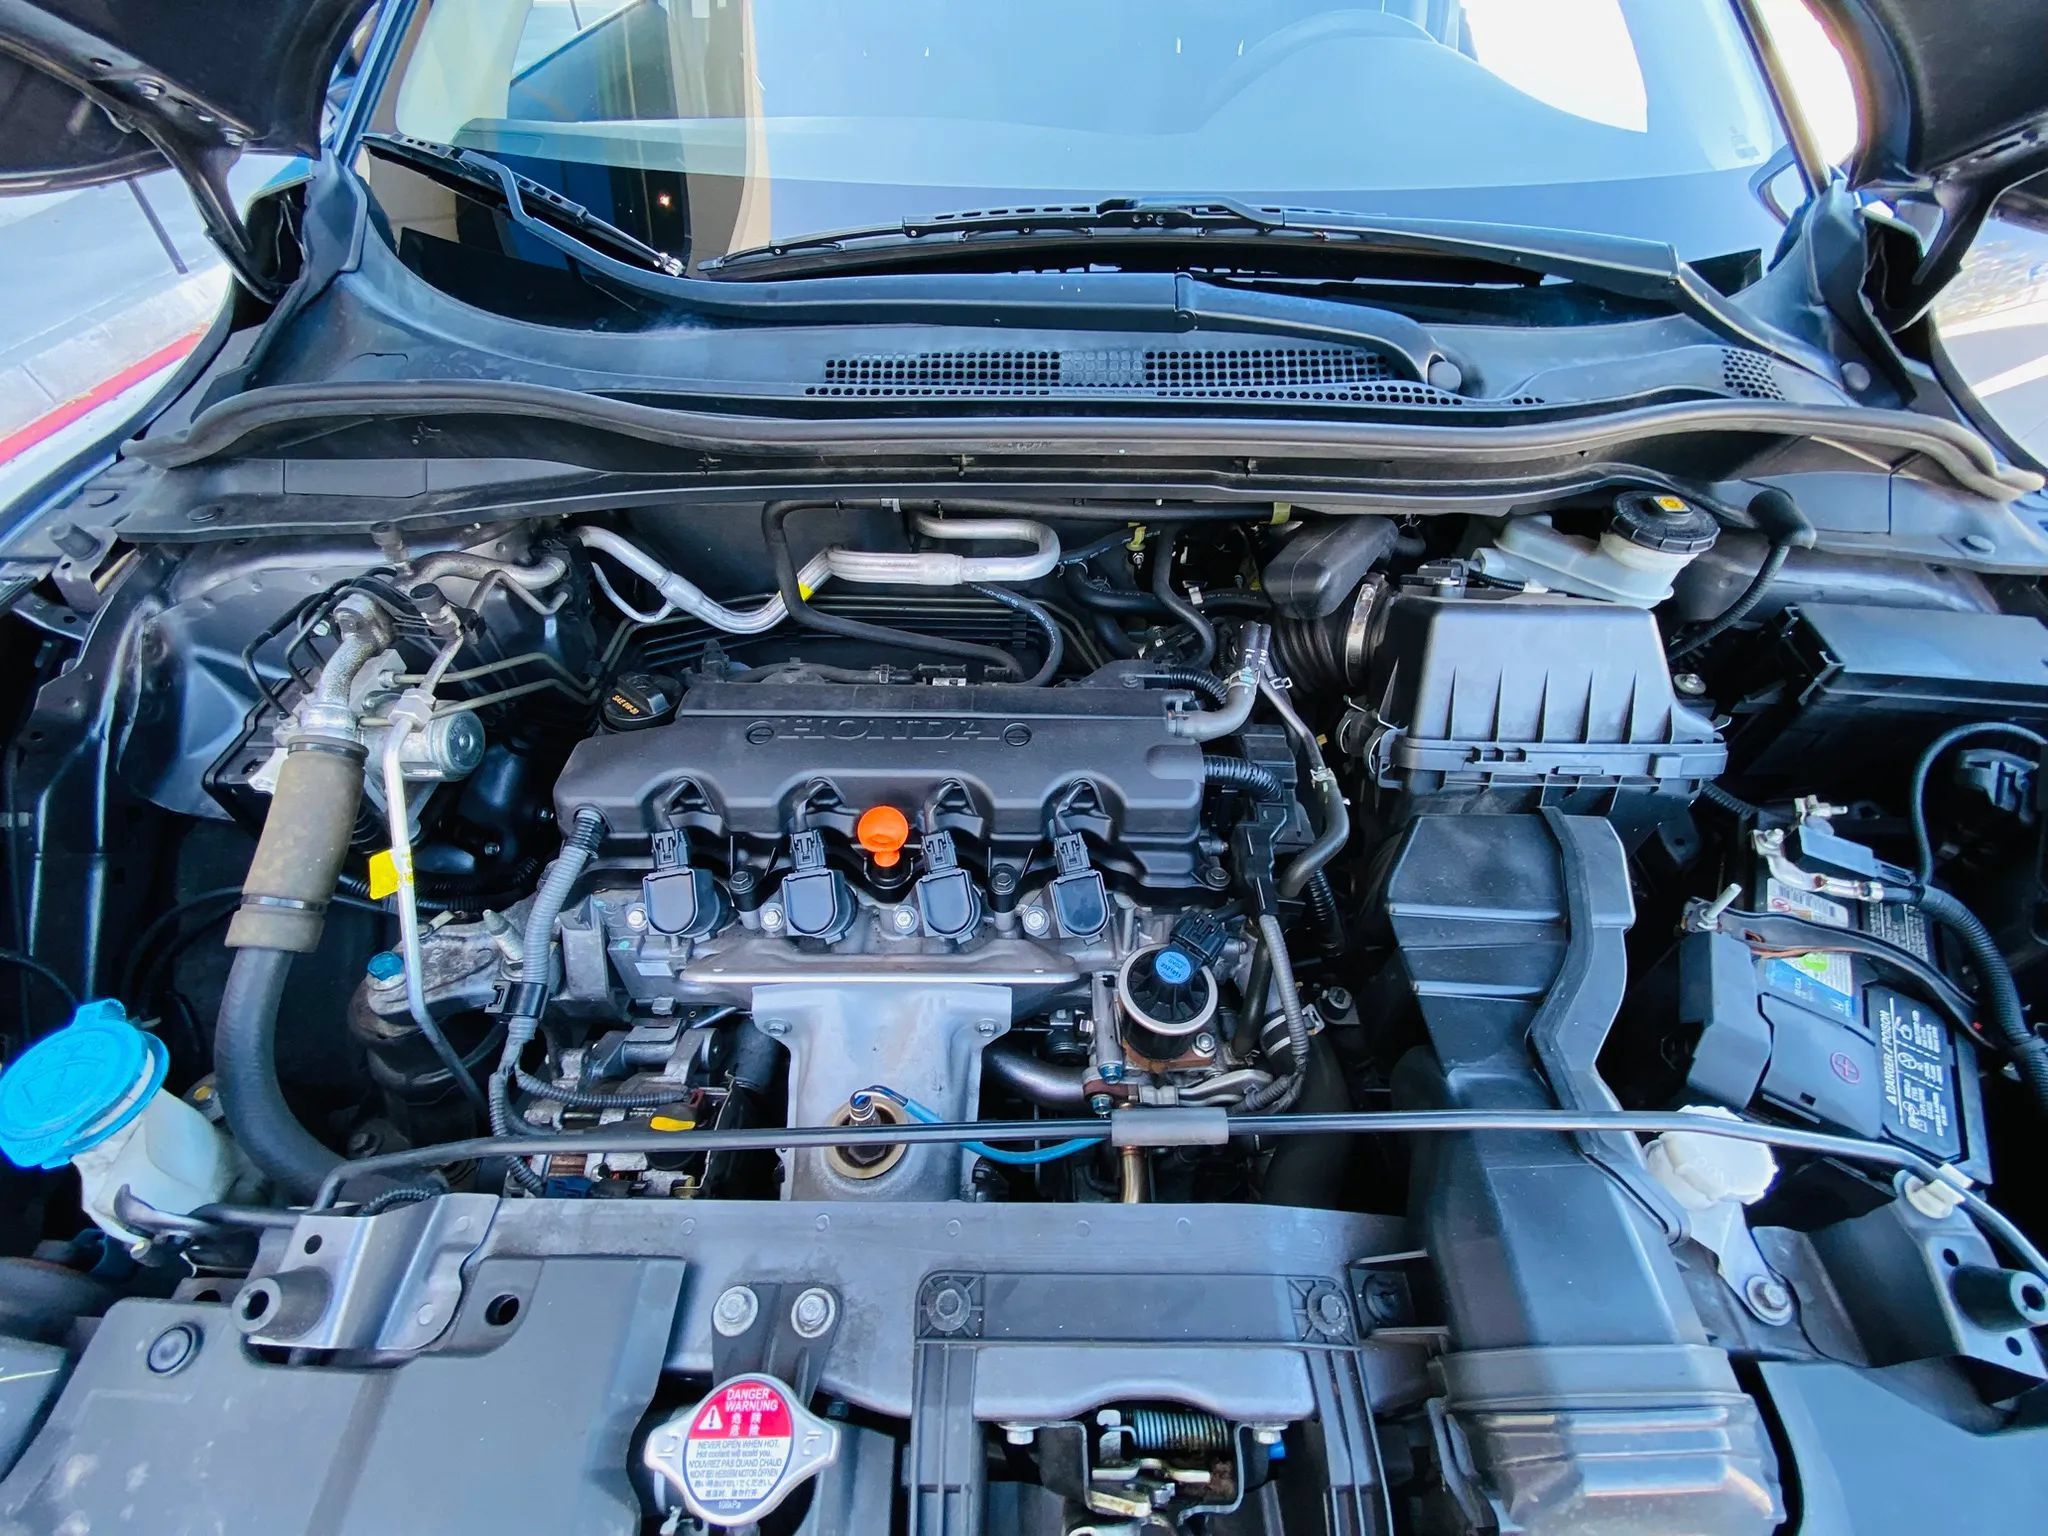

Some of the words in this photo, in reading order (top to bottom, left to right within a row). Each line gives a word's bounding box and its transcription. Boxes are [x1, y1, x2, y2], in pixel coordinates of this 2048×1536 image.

[777, 719, 1000, 740] HONDA
[727, 1389, 770, 1400] DANGER
[726, 1400, 779, 1412] WARNUNG
[698, 1441, 720, 1449] NEVER
[722, 1440, 740, 1449] OPEN
[742, 1440, 762, 1448] WHEN
[696, 1450, 707, 1458] Hot
[721, 1460, 734, 1468] PAS
[735, 1459, 759, 1468] QUAND
